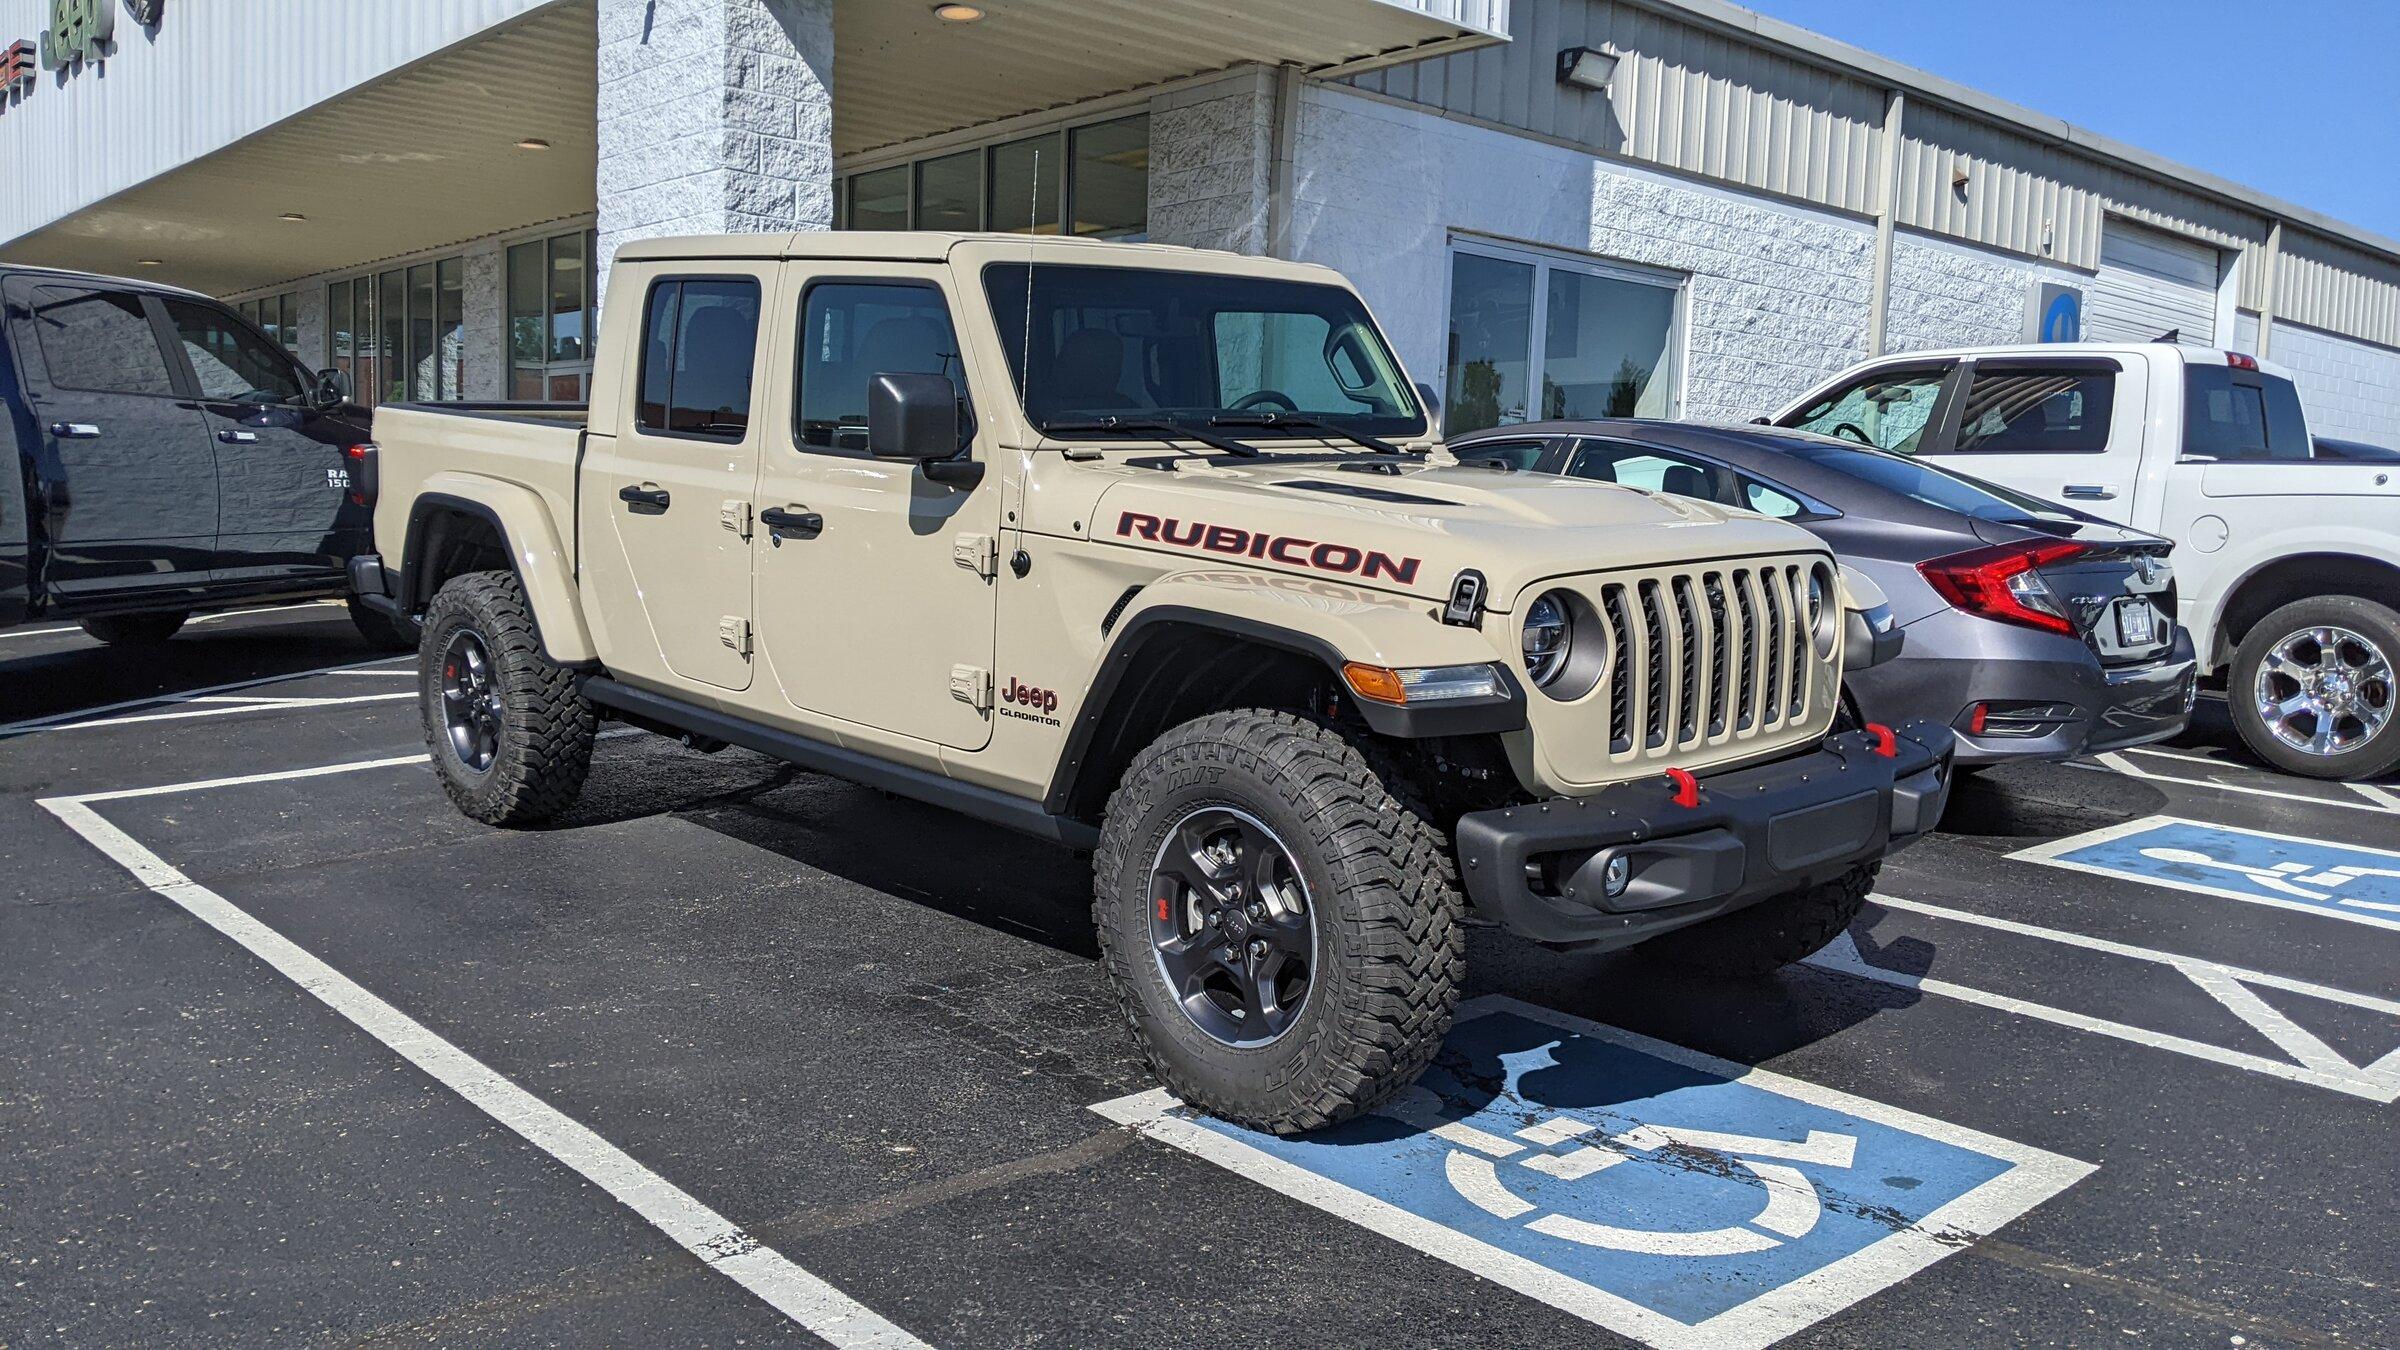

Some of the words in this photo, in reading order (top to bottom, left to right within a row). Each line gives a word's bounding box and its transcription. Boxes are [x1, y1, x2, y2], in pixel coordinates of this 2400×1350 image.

[326, 469, 349, 479] RA
[1116, 510, 1422, 585] RUBICON
[1001, 676, 1058, 716] Jeep
[999, 707, 1061, 728] GLADIATOR
[1166, 765, 1226, 796] M/T
